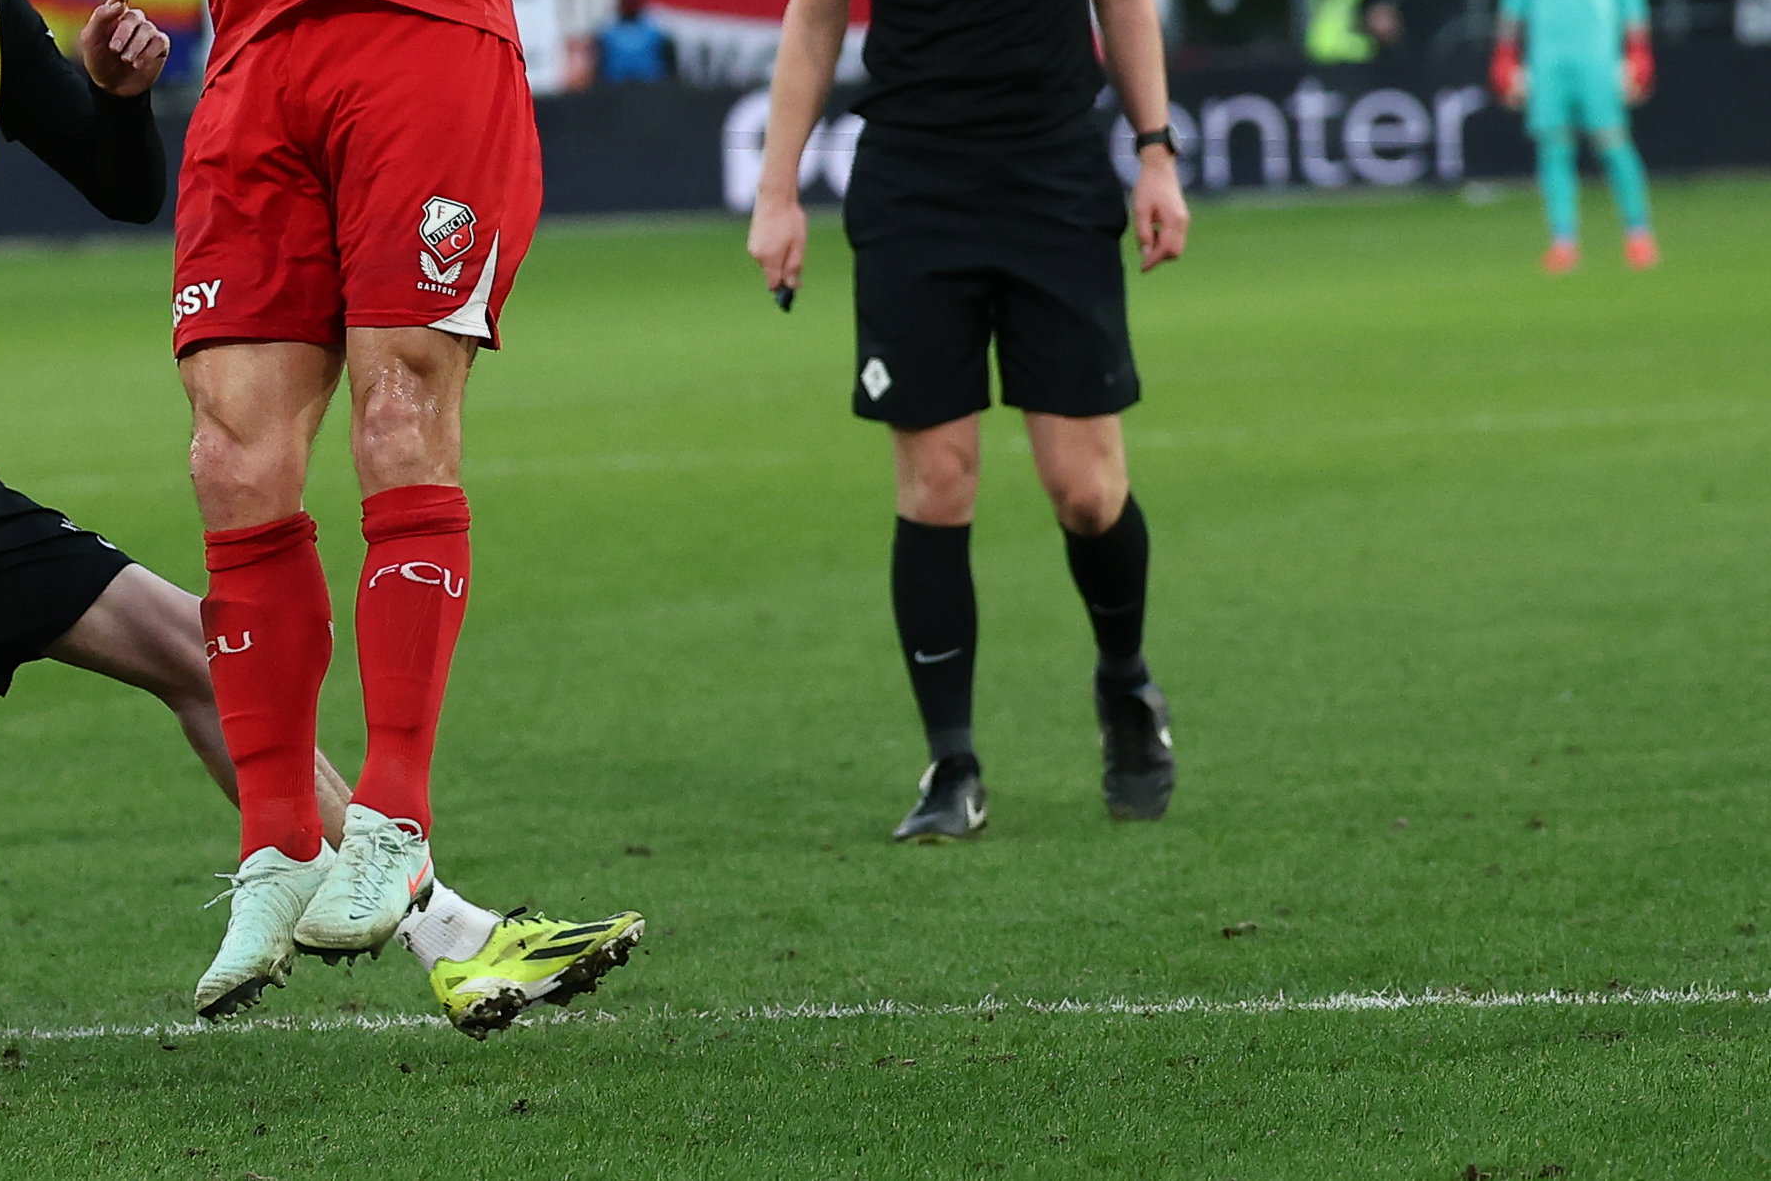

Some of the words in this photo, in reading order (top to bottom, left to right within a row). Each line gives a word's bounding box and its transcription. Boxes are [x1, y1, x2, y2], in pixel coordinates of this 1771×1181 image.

[437, 205, 446, 220] F
[427, 210, 471, 246] UTRECHT
[450, 233, 464, 250] C
